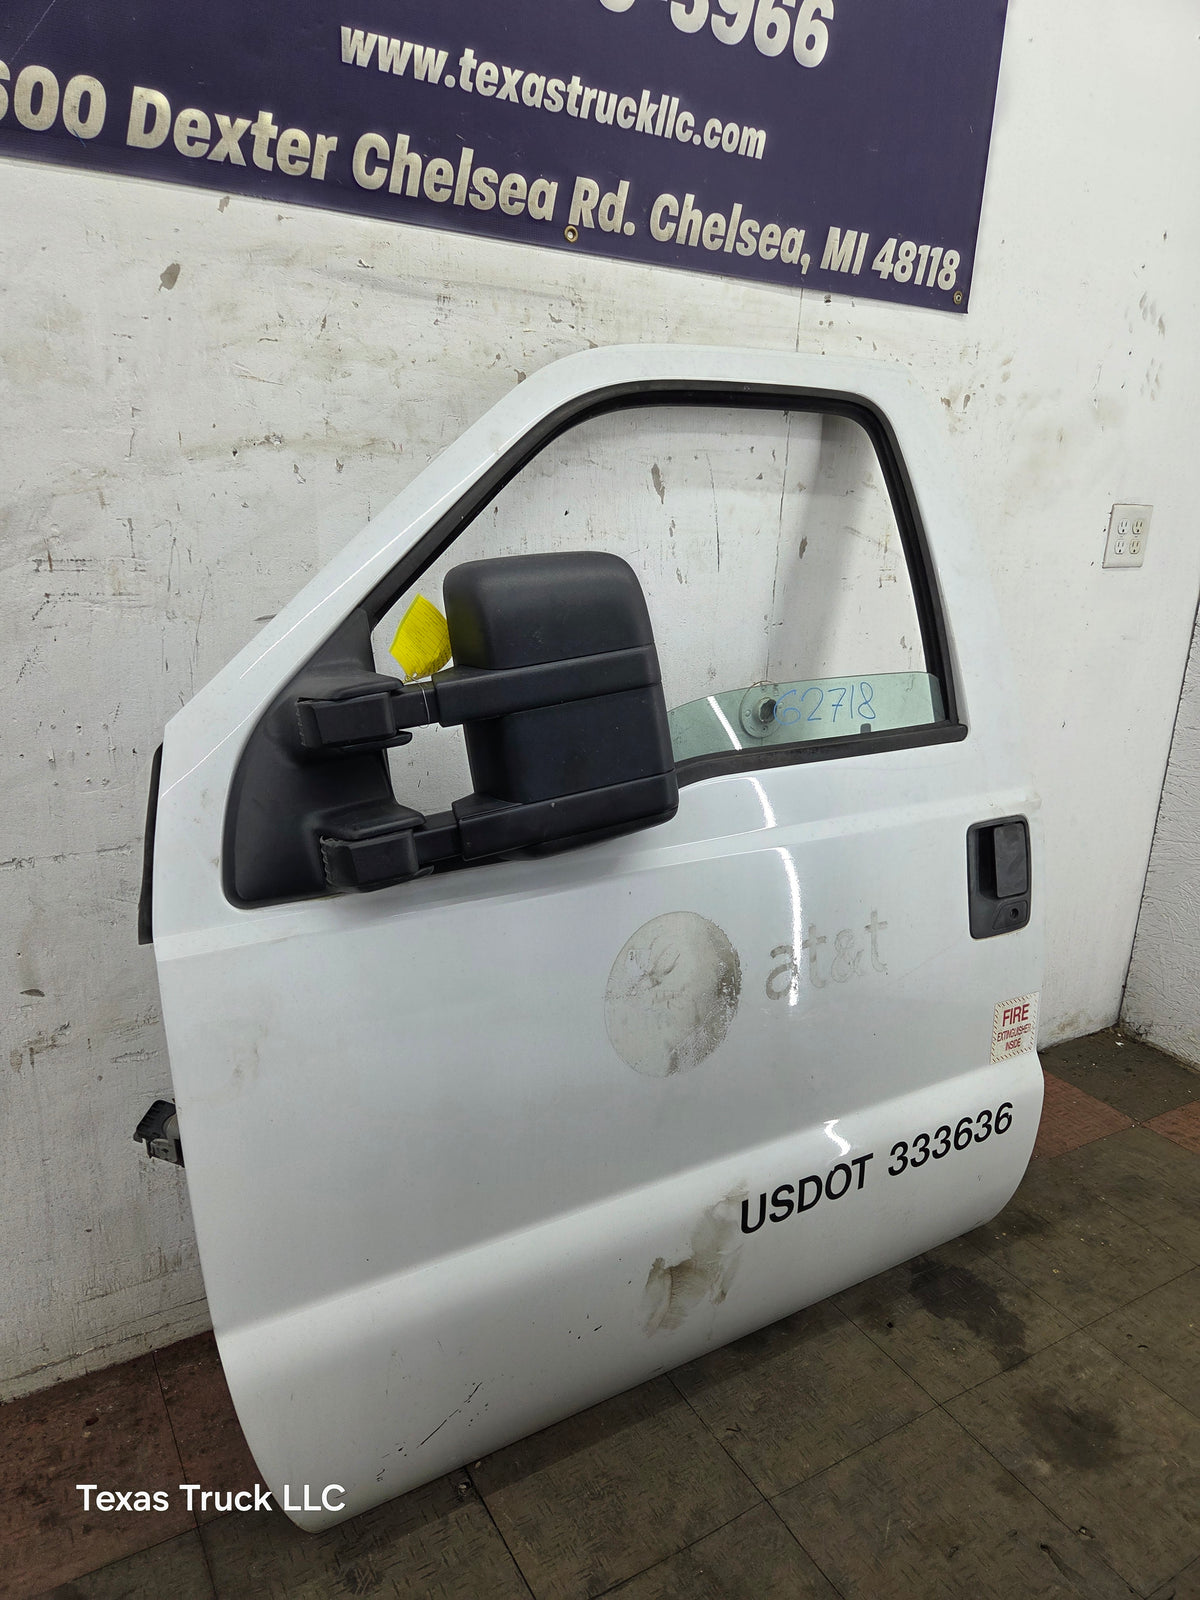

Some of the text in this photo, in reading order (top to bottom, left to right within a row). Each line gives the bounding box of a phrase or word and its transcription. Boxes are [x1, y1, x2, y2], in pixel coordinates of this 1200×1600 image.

[340, 25, 767, 160] www.texastruckllc.com
[0, 59, 961, 292] 00 Dexter Chelsea Rd. Chelsea, MI 48118
[773, 681, 876, 726] 62718
[765, 910, 889, 1001] at&t
[1002, 1003, 1030, 1027] FIRE
[740, 1101, 1013, 1234] USDOT 333636
